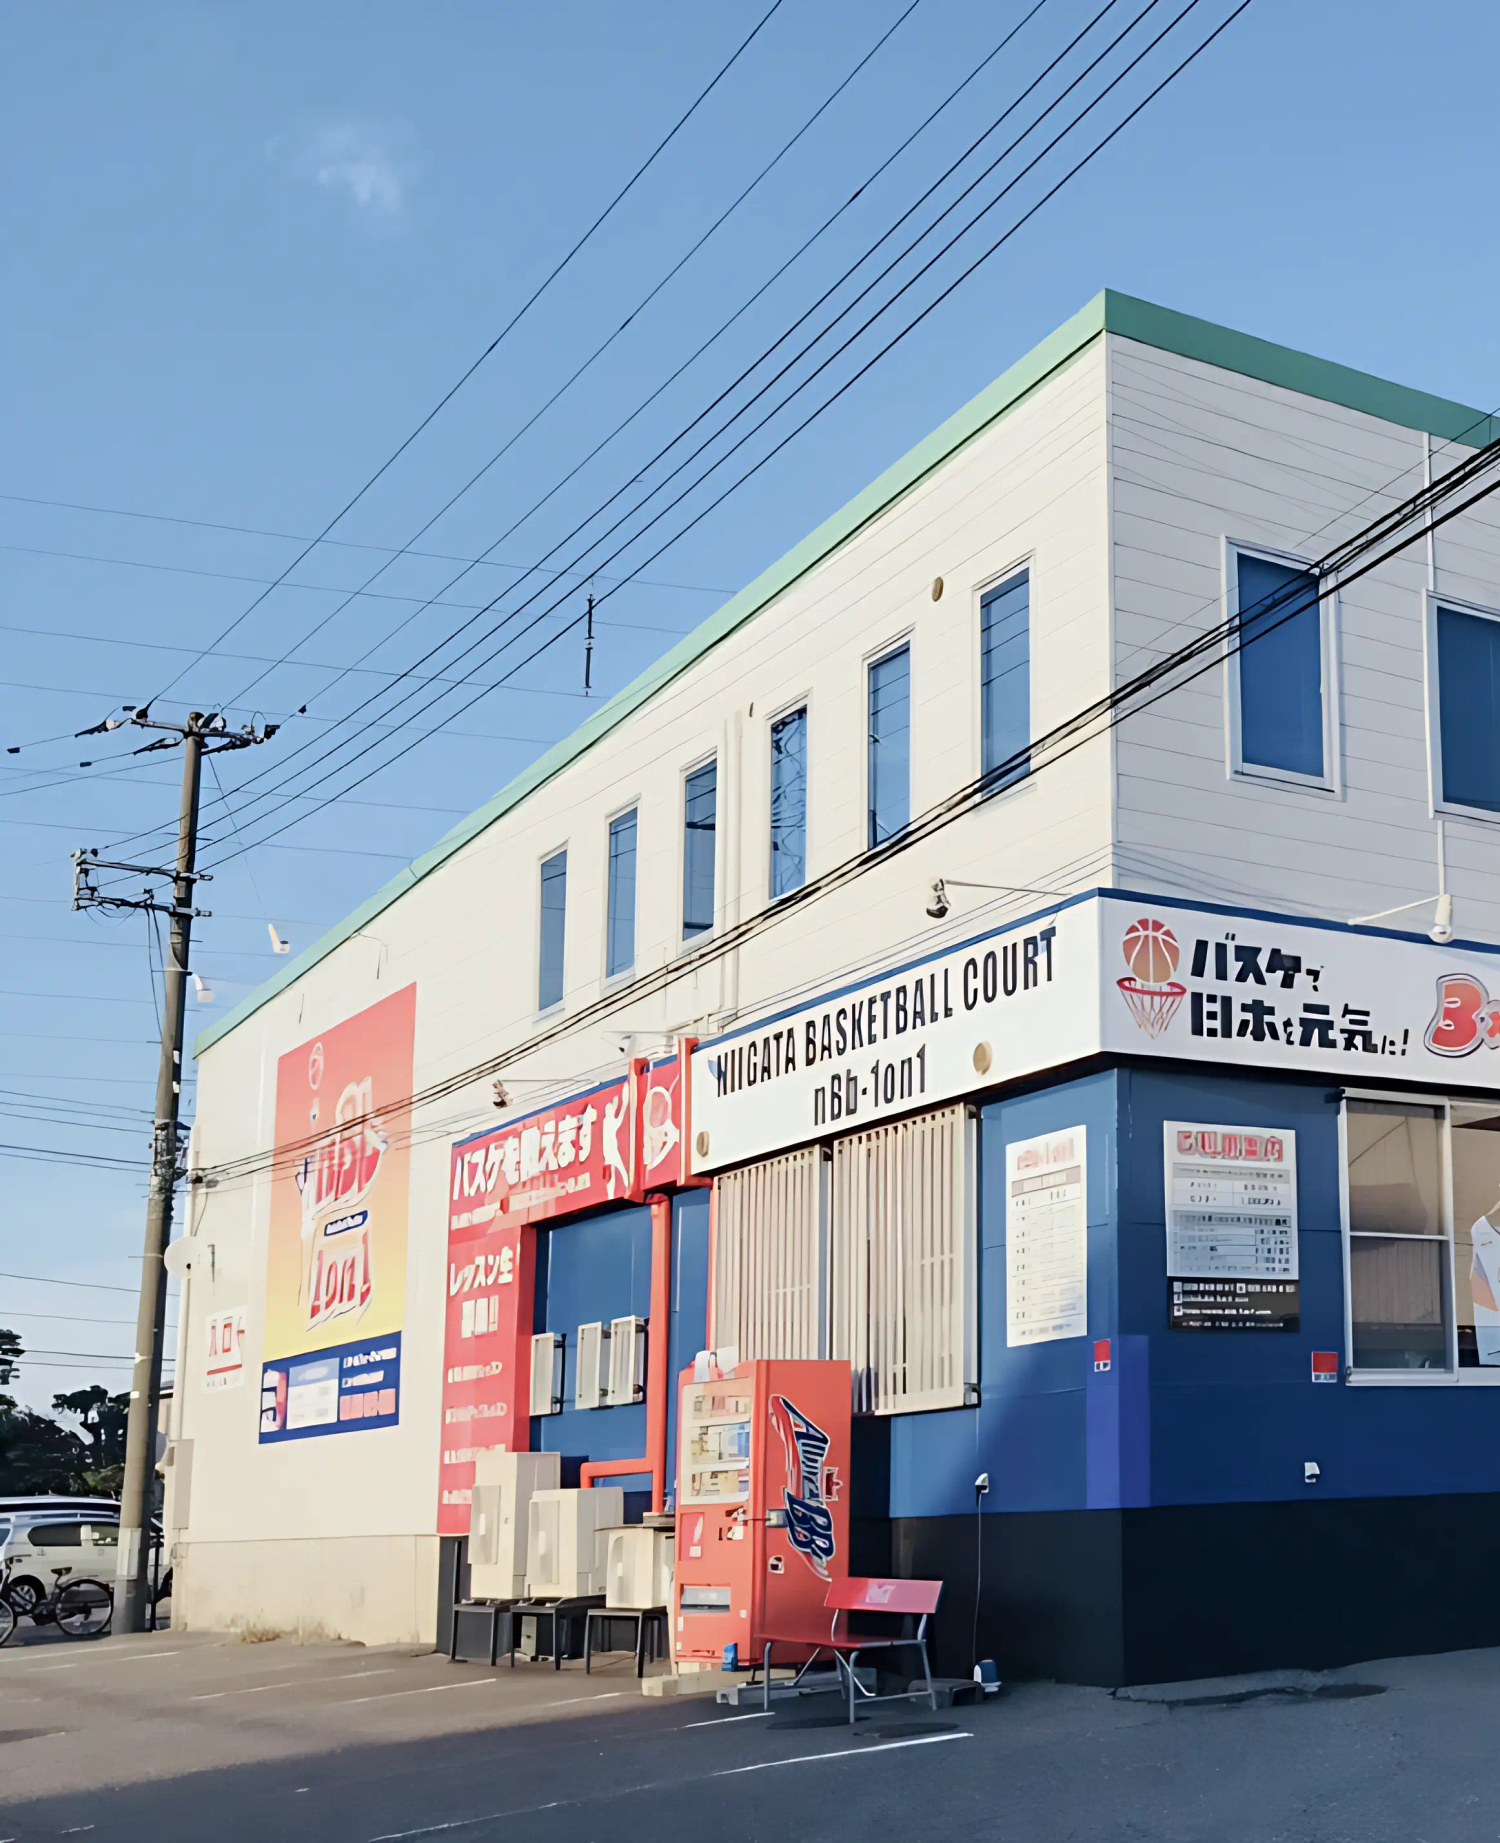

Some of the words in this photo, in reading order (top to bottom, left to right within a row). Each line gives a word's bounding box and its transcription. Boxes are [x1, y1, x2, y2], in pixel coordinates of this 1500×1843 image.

[715, 1026, 797, 1098] NIIGATA
[805, 967, 954, 1067] BASKETBALL
[963, 926, 1058, 1011] COURT
